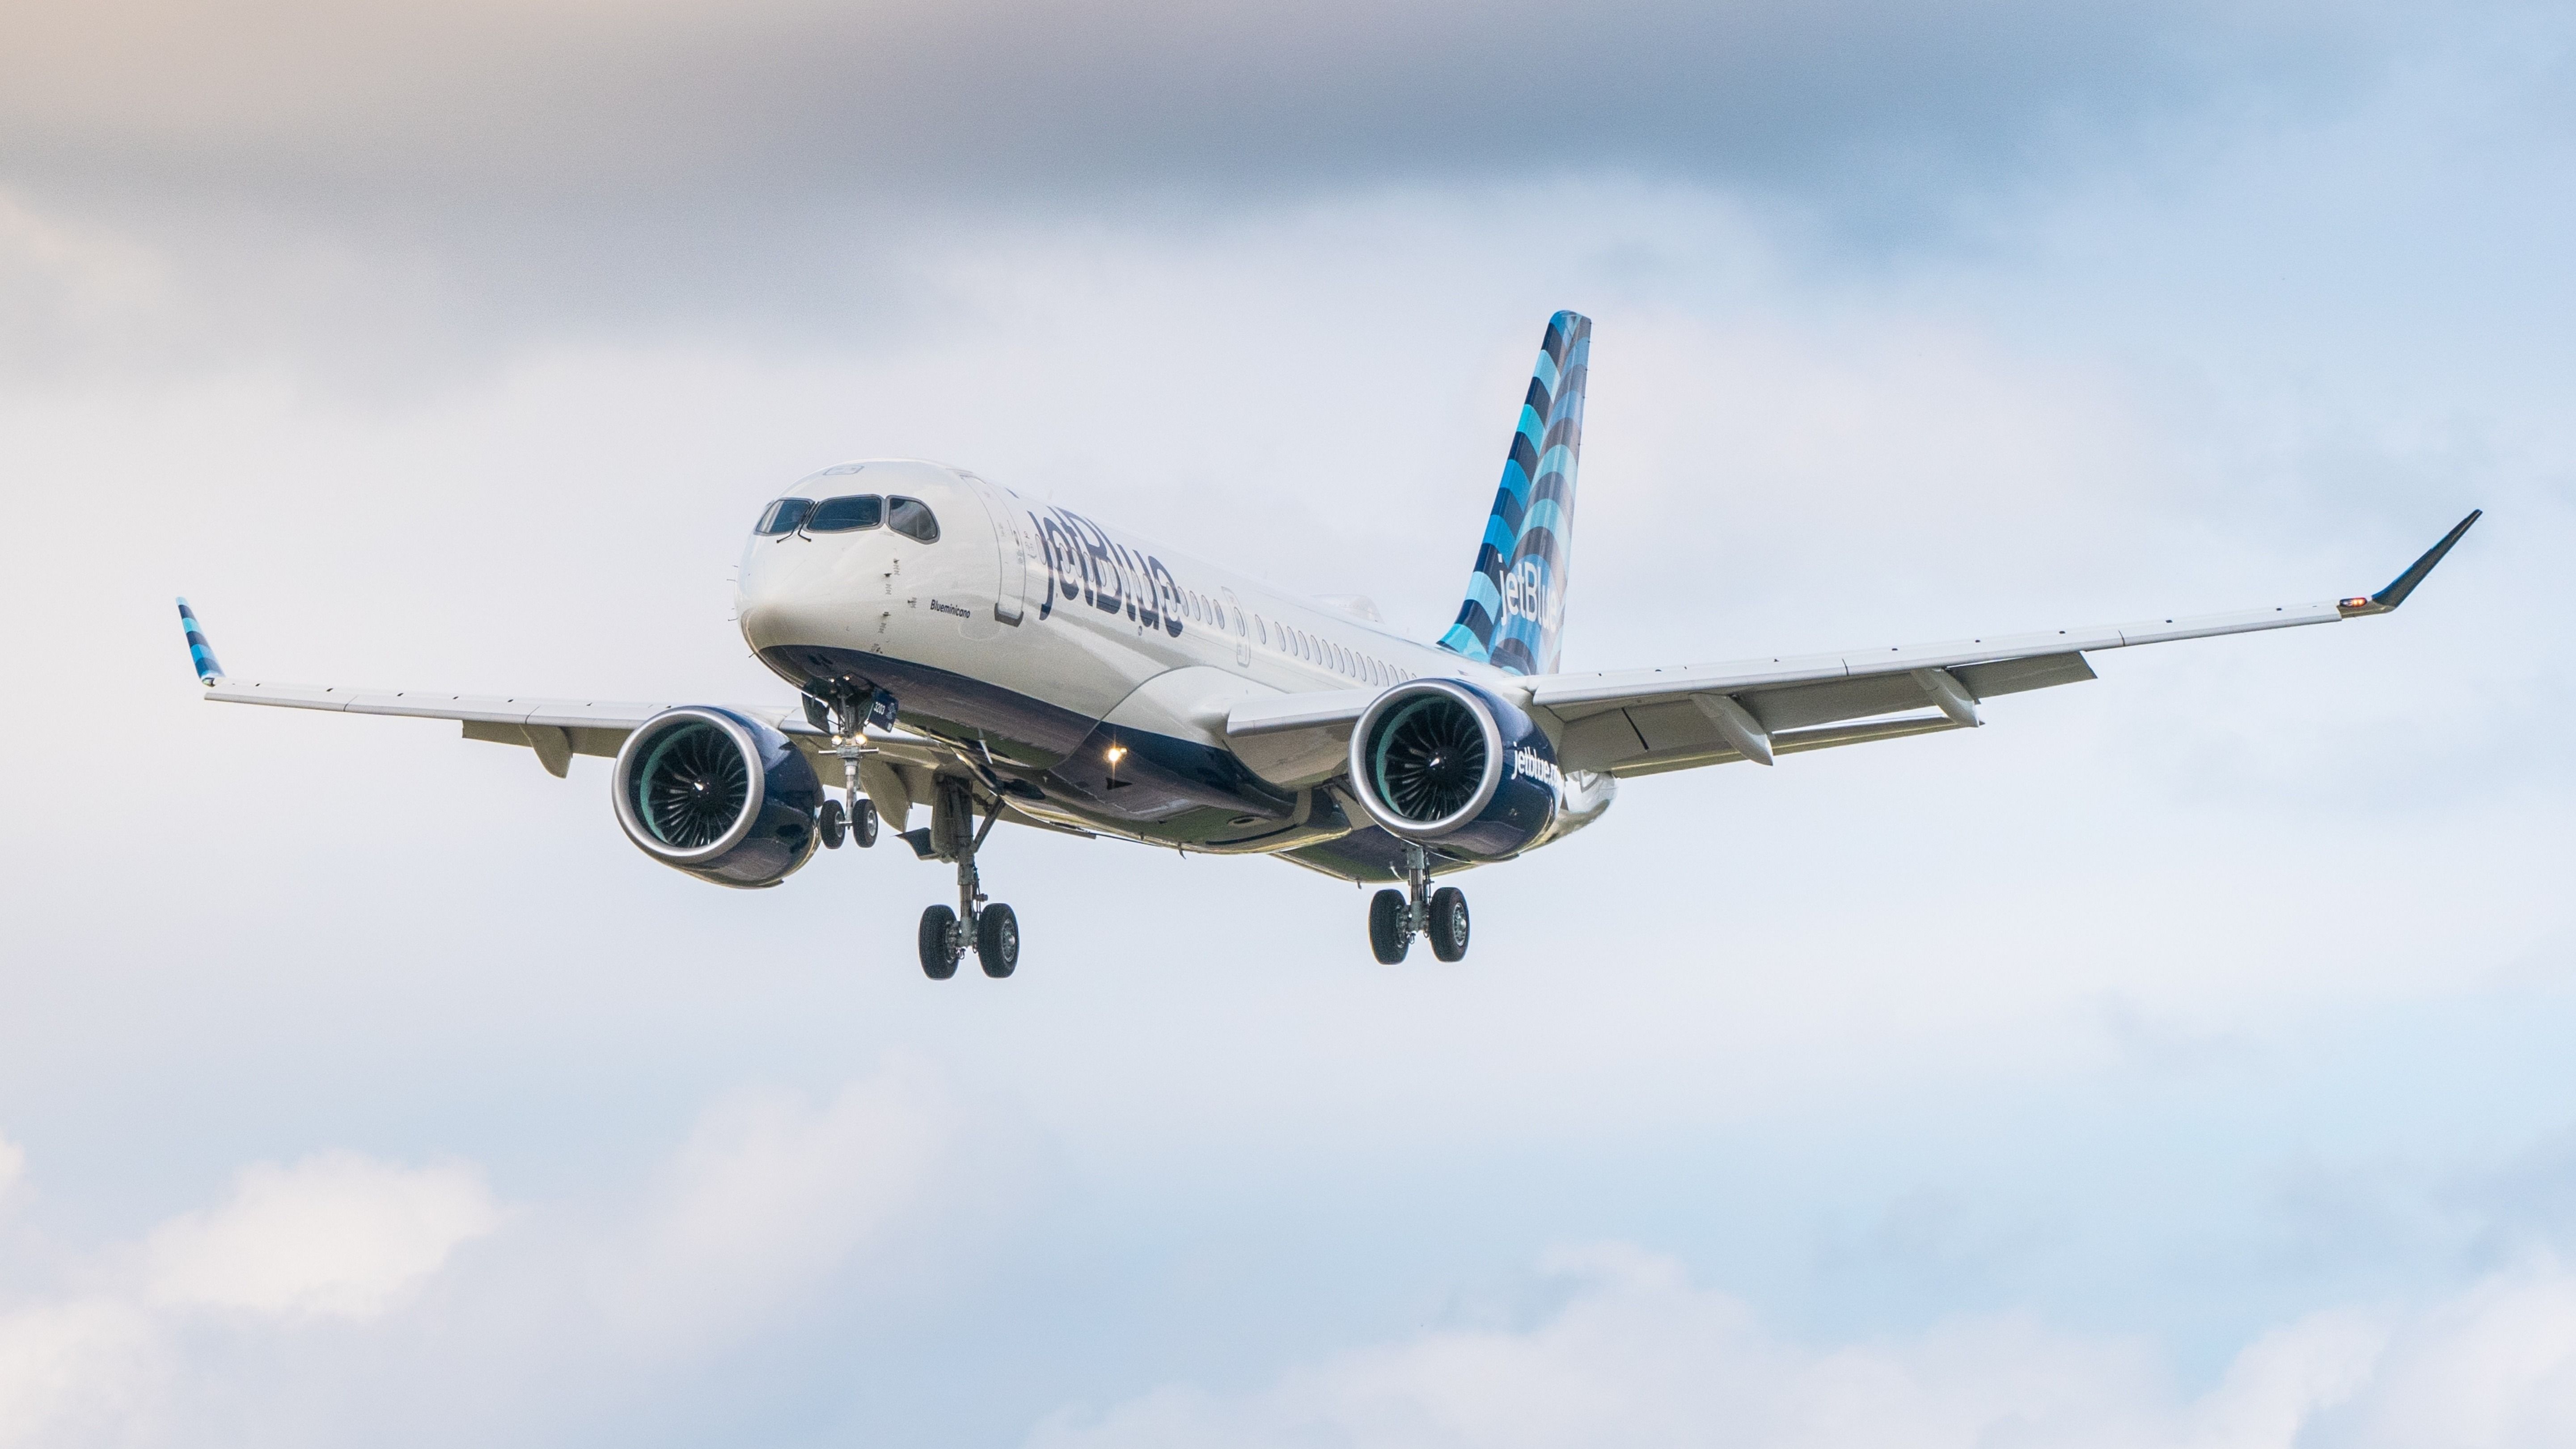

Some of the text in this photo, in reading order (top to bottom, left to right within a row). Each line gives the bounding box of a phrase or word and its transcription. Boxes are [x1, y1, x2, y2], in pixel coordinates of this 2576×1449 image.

[1005, 488, 1184, 638] jetBlue
[1498, 553, 1557, 633] jetBlue
[930, 599, 970, 618] Blueminicano
